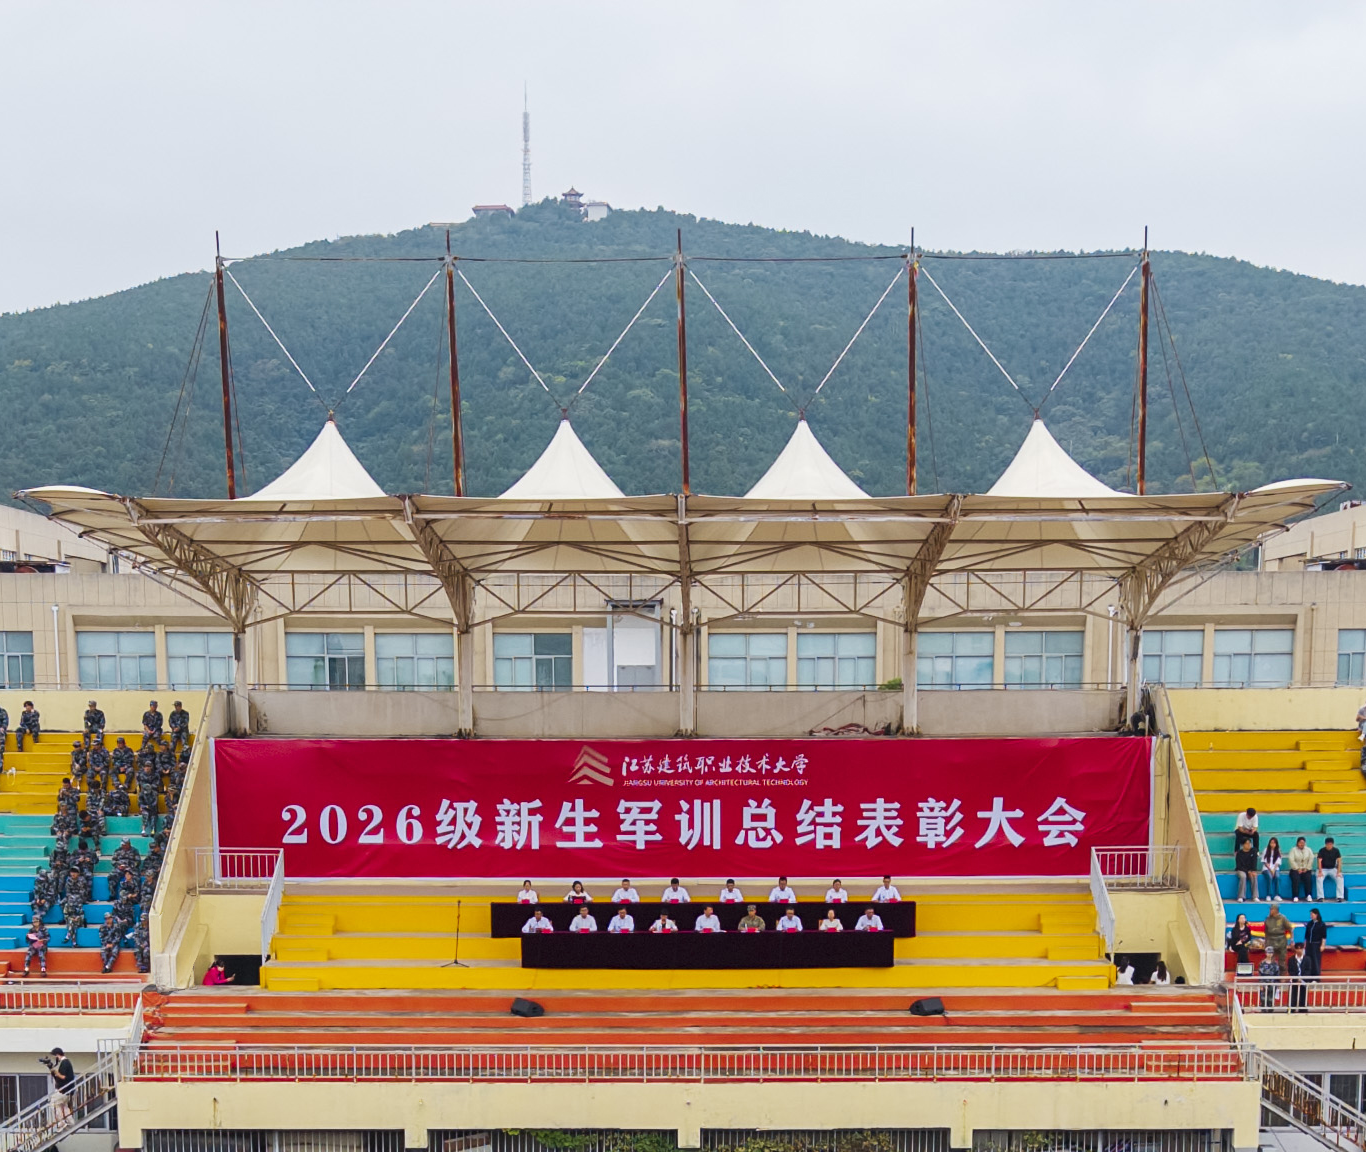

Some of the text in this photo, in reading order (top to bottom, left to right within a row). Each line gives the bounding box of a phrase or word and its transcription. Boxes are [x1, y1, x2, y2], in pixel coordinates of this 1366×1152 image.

[621, 753, 809, 776] 江苏建筑职业技术大学
[281, 797, 1086, 851] 2026级新生军训总结表彰大会
